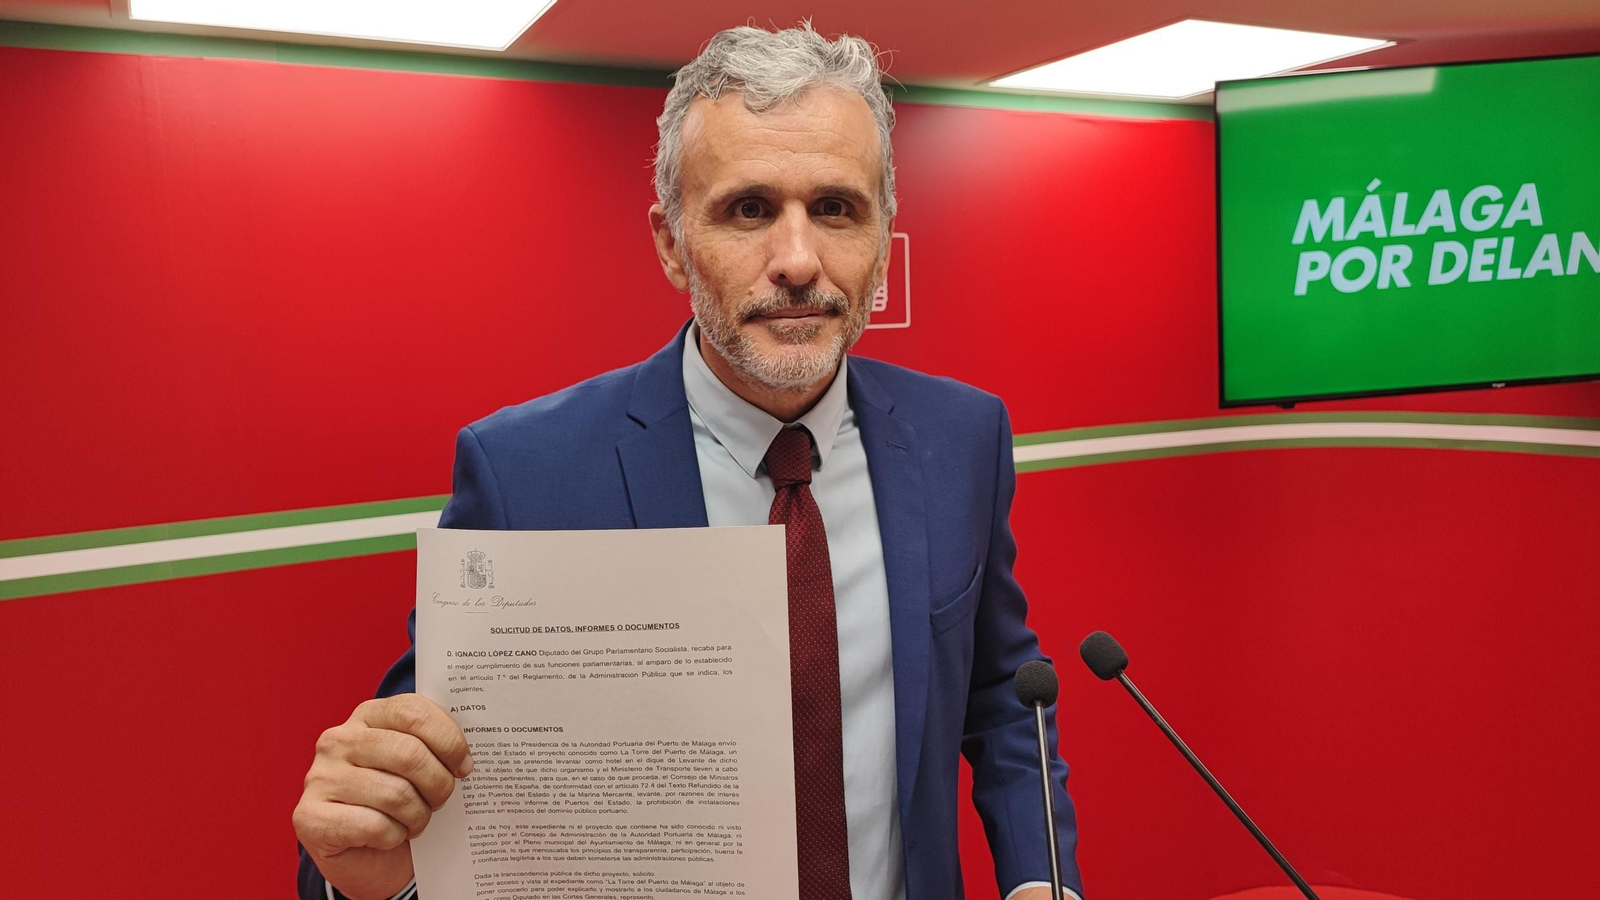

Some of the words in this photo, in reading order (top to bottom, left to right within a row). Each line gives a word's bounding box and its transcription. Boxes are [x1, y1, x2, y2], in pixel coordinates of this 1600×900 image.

[1292, 178, 1543, 244] MÁLAGA
[1294, 245, 1413, 296] POR
[432, 592, 458, 608] Congreso
[462, 598, 470, 606] de
[474, 597, 486, 606] los
[490, 595, 537, 610] Diputados
